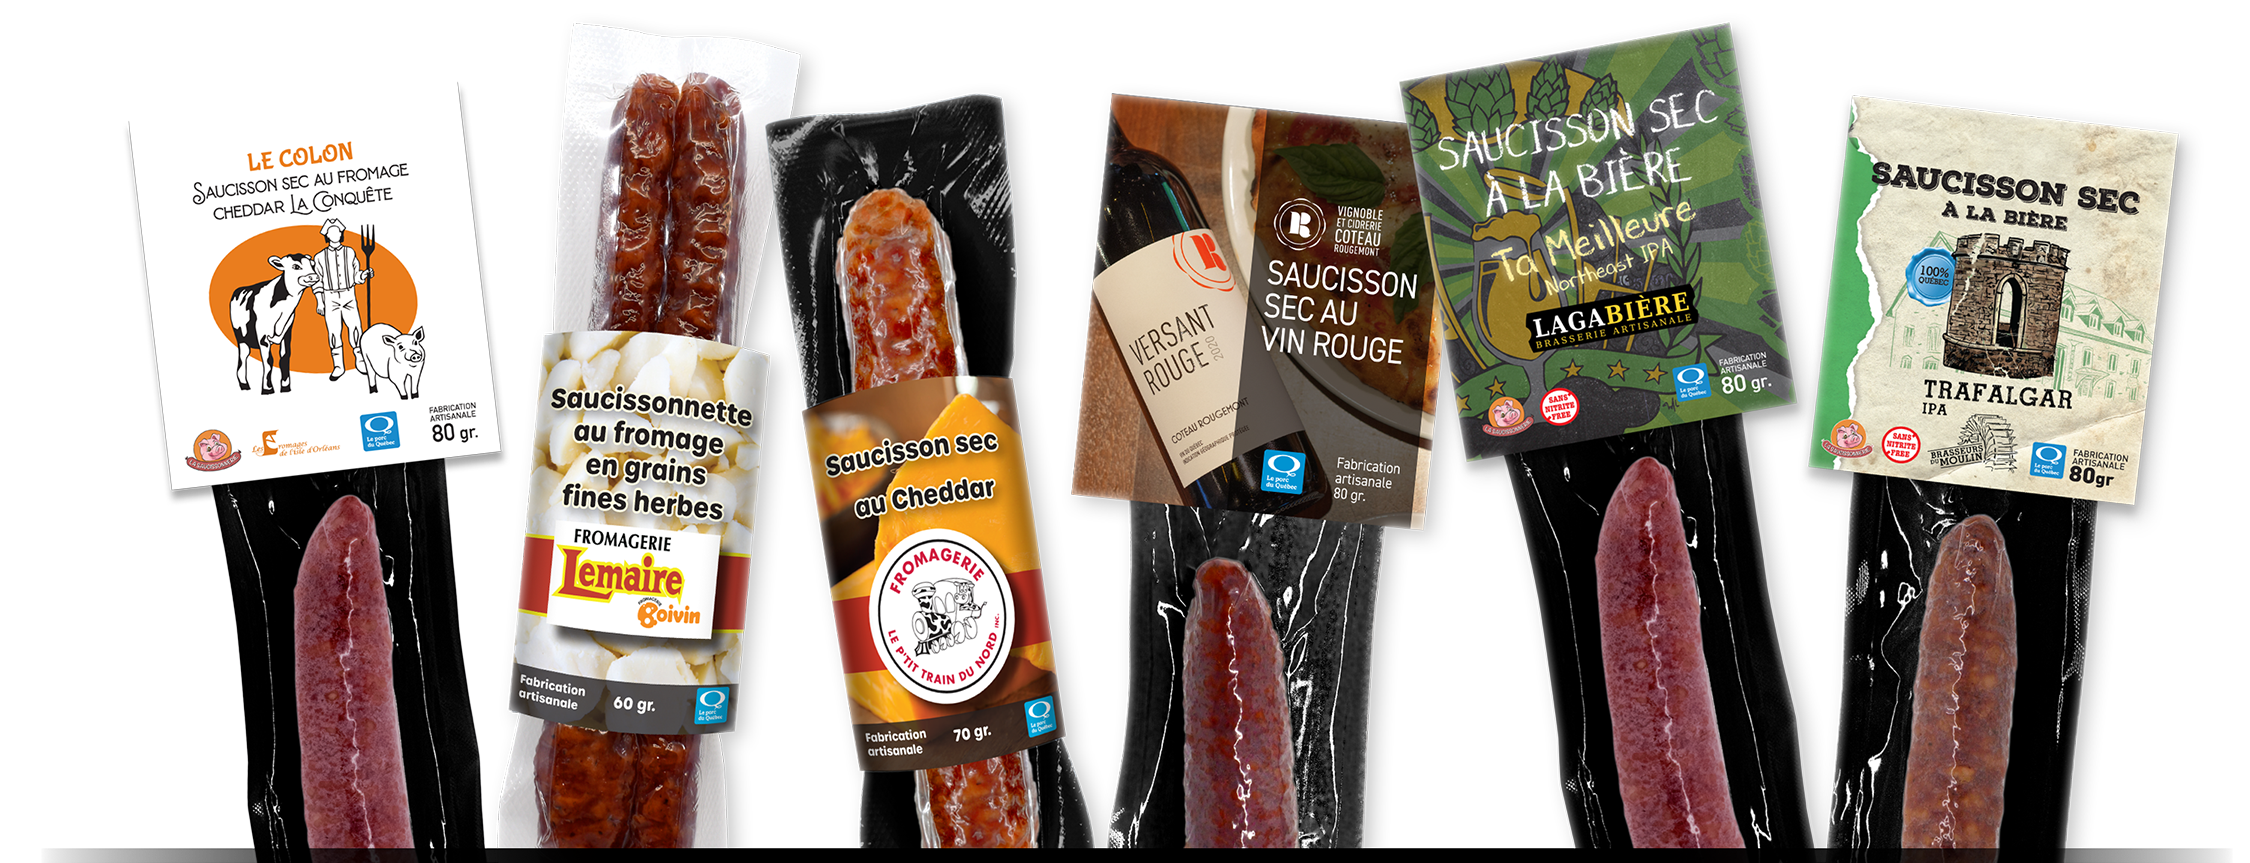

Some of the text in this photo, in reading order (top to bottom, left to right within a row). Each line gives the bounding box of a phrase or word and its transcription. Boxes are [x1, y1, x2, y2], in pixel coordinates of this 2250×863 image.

[1438, 89, 1718, 171] SAUCISSON SEC
[247, 141, 353, 171] LE COLON
[1486, 147, 1693, 218] À LA BIÈRE
[1871, 161, 2140, 215] SAUCISSON SEC
[1337, 205, 1384, 220] VIGNOBLE
[1941, 200, 2068, 232] À LA BIÈRE
[1336, 218, 1382, 231] ET CIDRERIE
[1335, 228, 1381, 247] COTEAU
[1491, 200, 1697, 281] Ta Meilleure
[1334, 244, 1380, 257] ROUGEMONT
[1544, 238, 1673, 296] Northeast IPA
[1920, 265, 1949, 279] 100%
[1266, 259, 1418, 300] SAUCISSON
[1918, 274, 1949, 287] QUÉBEC
[1264, 292, 1358, 326] SEC AU
[1533, 292, 1690, 339] LAGABIÈRE
[1129, 304, 1214, 365] VERSANT
[1536, 313, 1693, 349] BRASSERIE ARTISANALE
[1204, 335, 1224, 361] 2020
[1261, 325, 1404, 365] VIN ROUGE
[1143, 341, 1209, 396] ROUGE
[1719, 351, 1767, 367] FABRICATION
[1720, 360, 1767, 375] ARTISANALE
[1688, 389, 1707, 398] Québec
[1721, 374, 1772, 394] 80 gr.
[1548, 394, 1569, 404] SANS
[1923, 379, 2073, 410] TRAFALGAR
[429, 402, 476, 414] FABRICATION
[551, 386, 752, 426] Saucissonnette
[1545, 401, 1575, 413] NITRITE
[1551, 410, 1572, 421] FREE
[1922, 402, 1947, 416] IPA
[430, 410, 476, 422] ARTISANALE
[1171, 397, 1249, 444] COTEAU ROUGEMONT
[374, 435, 387, 443] porc
[432, 423, 478, 443] 80 gr.
[574, 421, 724, 457] au fromage
[1892, 432, 1912, 441] SANS
[375, 440, 395, 448] Québec
[1886, 440, 1916, 450] NITRITE
[1890, 449, 1910, 458] FREE
[1930, 445, 1984, 459] BRASSEURS
[825, 434, 998, 476] Saucisson sec
[1940, 452, 1983, 466] MOULIN
[2072, 457, 2125, 471] ARTISANALE
[2073, 449, 2129, 463] FABRICATION
[586, 457, 706, 484] en grains
[1337, 457, 1401, 474] Fabrication
[1275, 476, 1290, 484] porc
[1275, 482, 1297, 490] Québec
[1335, 474, 1393, 489] artisanale
[563, 483, 723, 520] fines herbes
[856, 479, 995, 518] au Cheddar
[1333, 487, 1366, 504] 80 gr.
[574, 528, 671, 552] FROMAGERIE
[553, 545, 684, 602] Lemaire
[889, 547, 985, 594] FROMAGERIE
[637, 602, 700, 628] Boivin
[888, 629, 900, 644] LE
[895, 646, 920, 673] P'TIT
[921, 668, 956, 685] TRAIN
[958, 666, 974, 682] DU
[975, 632, 998, 669] NORD
[520, 674, 585, 697] Fabrication
[519, 689, 578, 710] artisanale
[613, 696, 656, 714] 60 gr.
[865, 729, 927, 743] Fabrication
[953, 725, 992, 742] 70 gr.
[867, 744, 923, 756] artisanale
